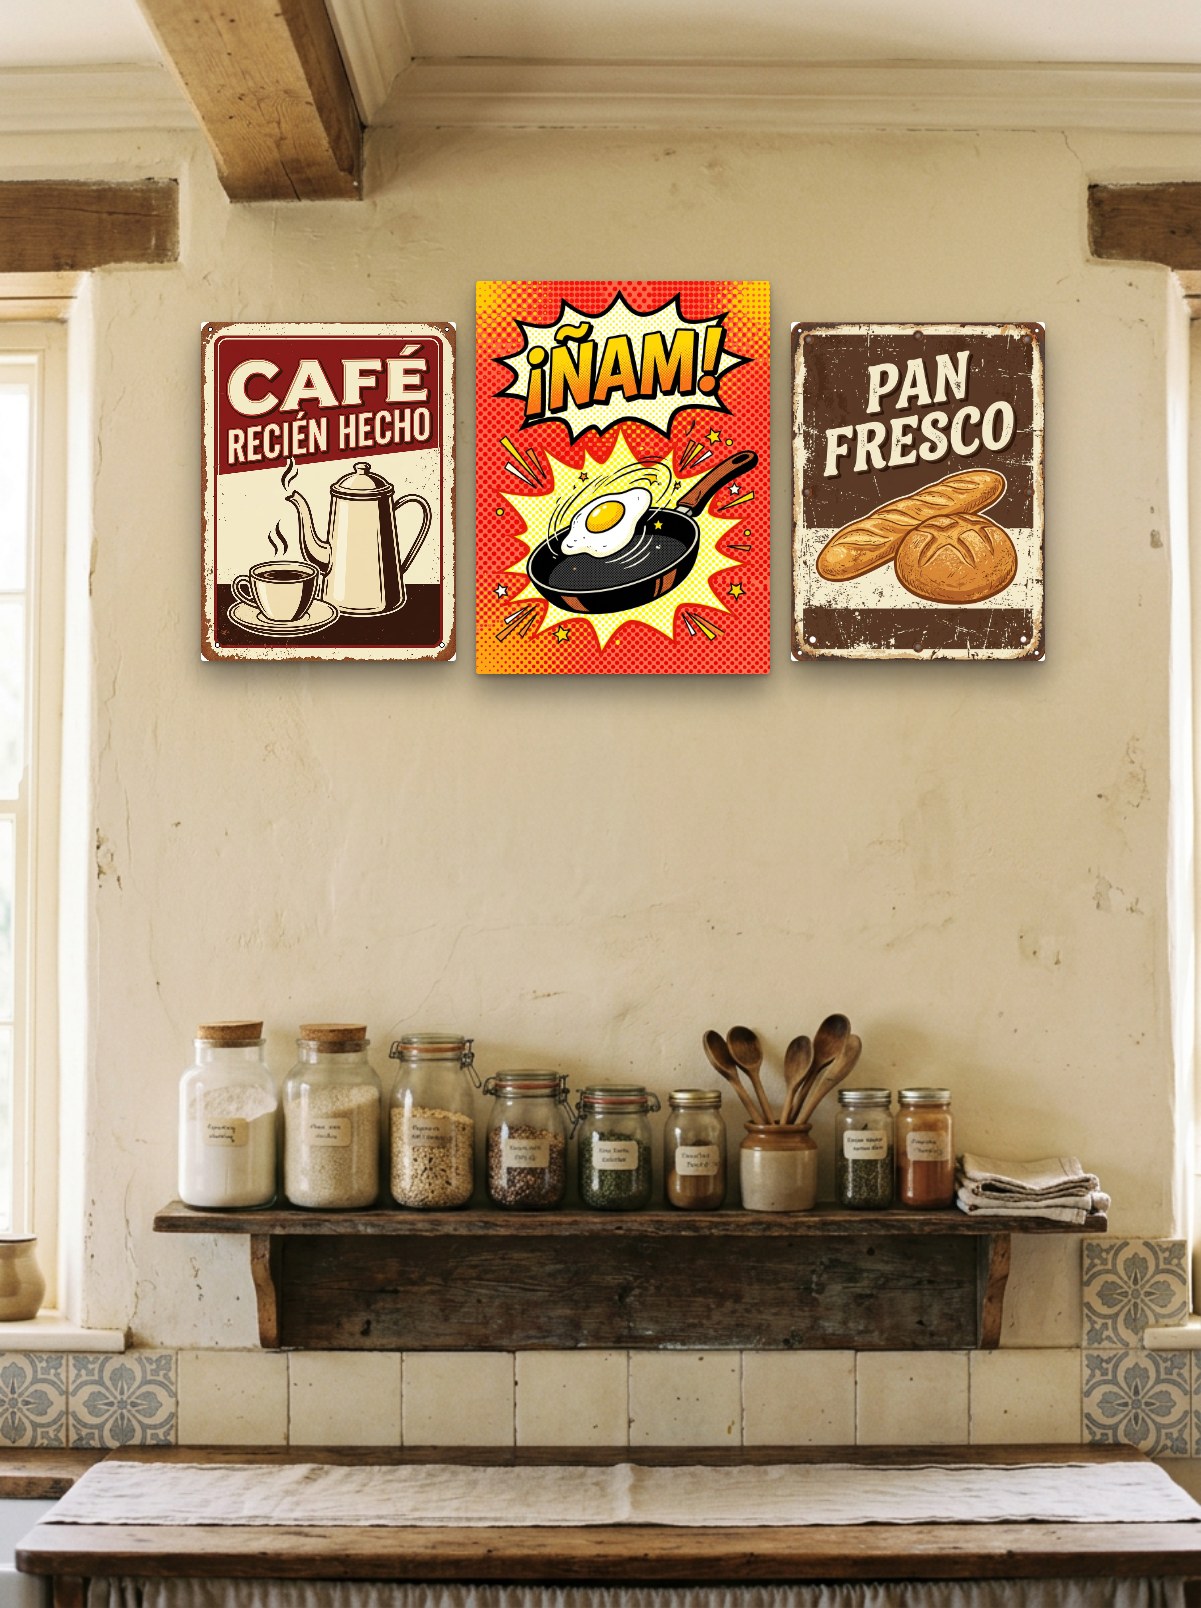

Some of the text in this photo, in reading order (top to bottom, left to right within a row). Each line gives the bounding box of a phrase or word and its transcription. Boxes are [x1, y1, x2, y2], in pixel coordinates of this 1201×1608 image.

[228, 344, 429, 417] CAFÉ
[524, 322, 726, 418] ¡ÑAM!
[866, 351, 970, 413] PAN
[228, 408, 431, 464] RECIÉN HECHO
[823, 401, 1015, 477] FRESCO
